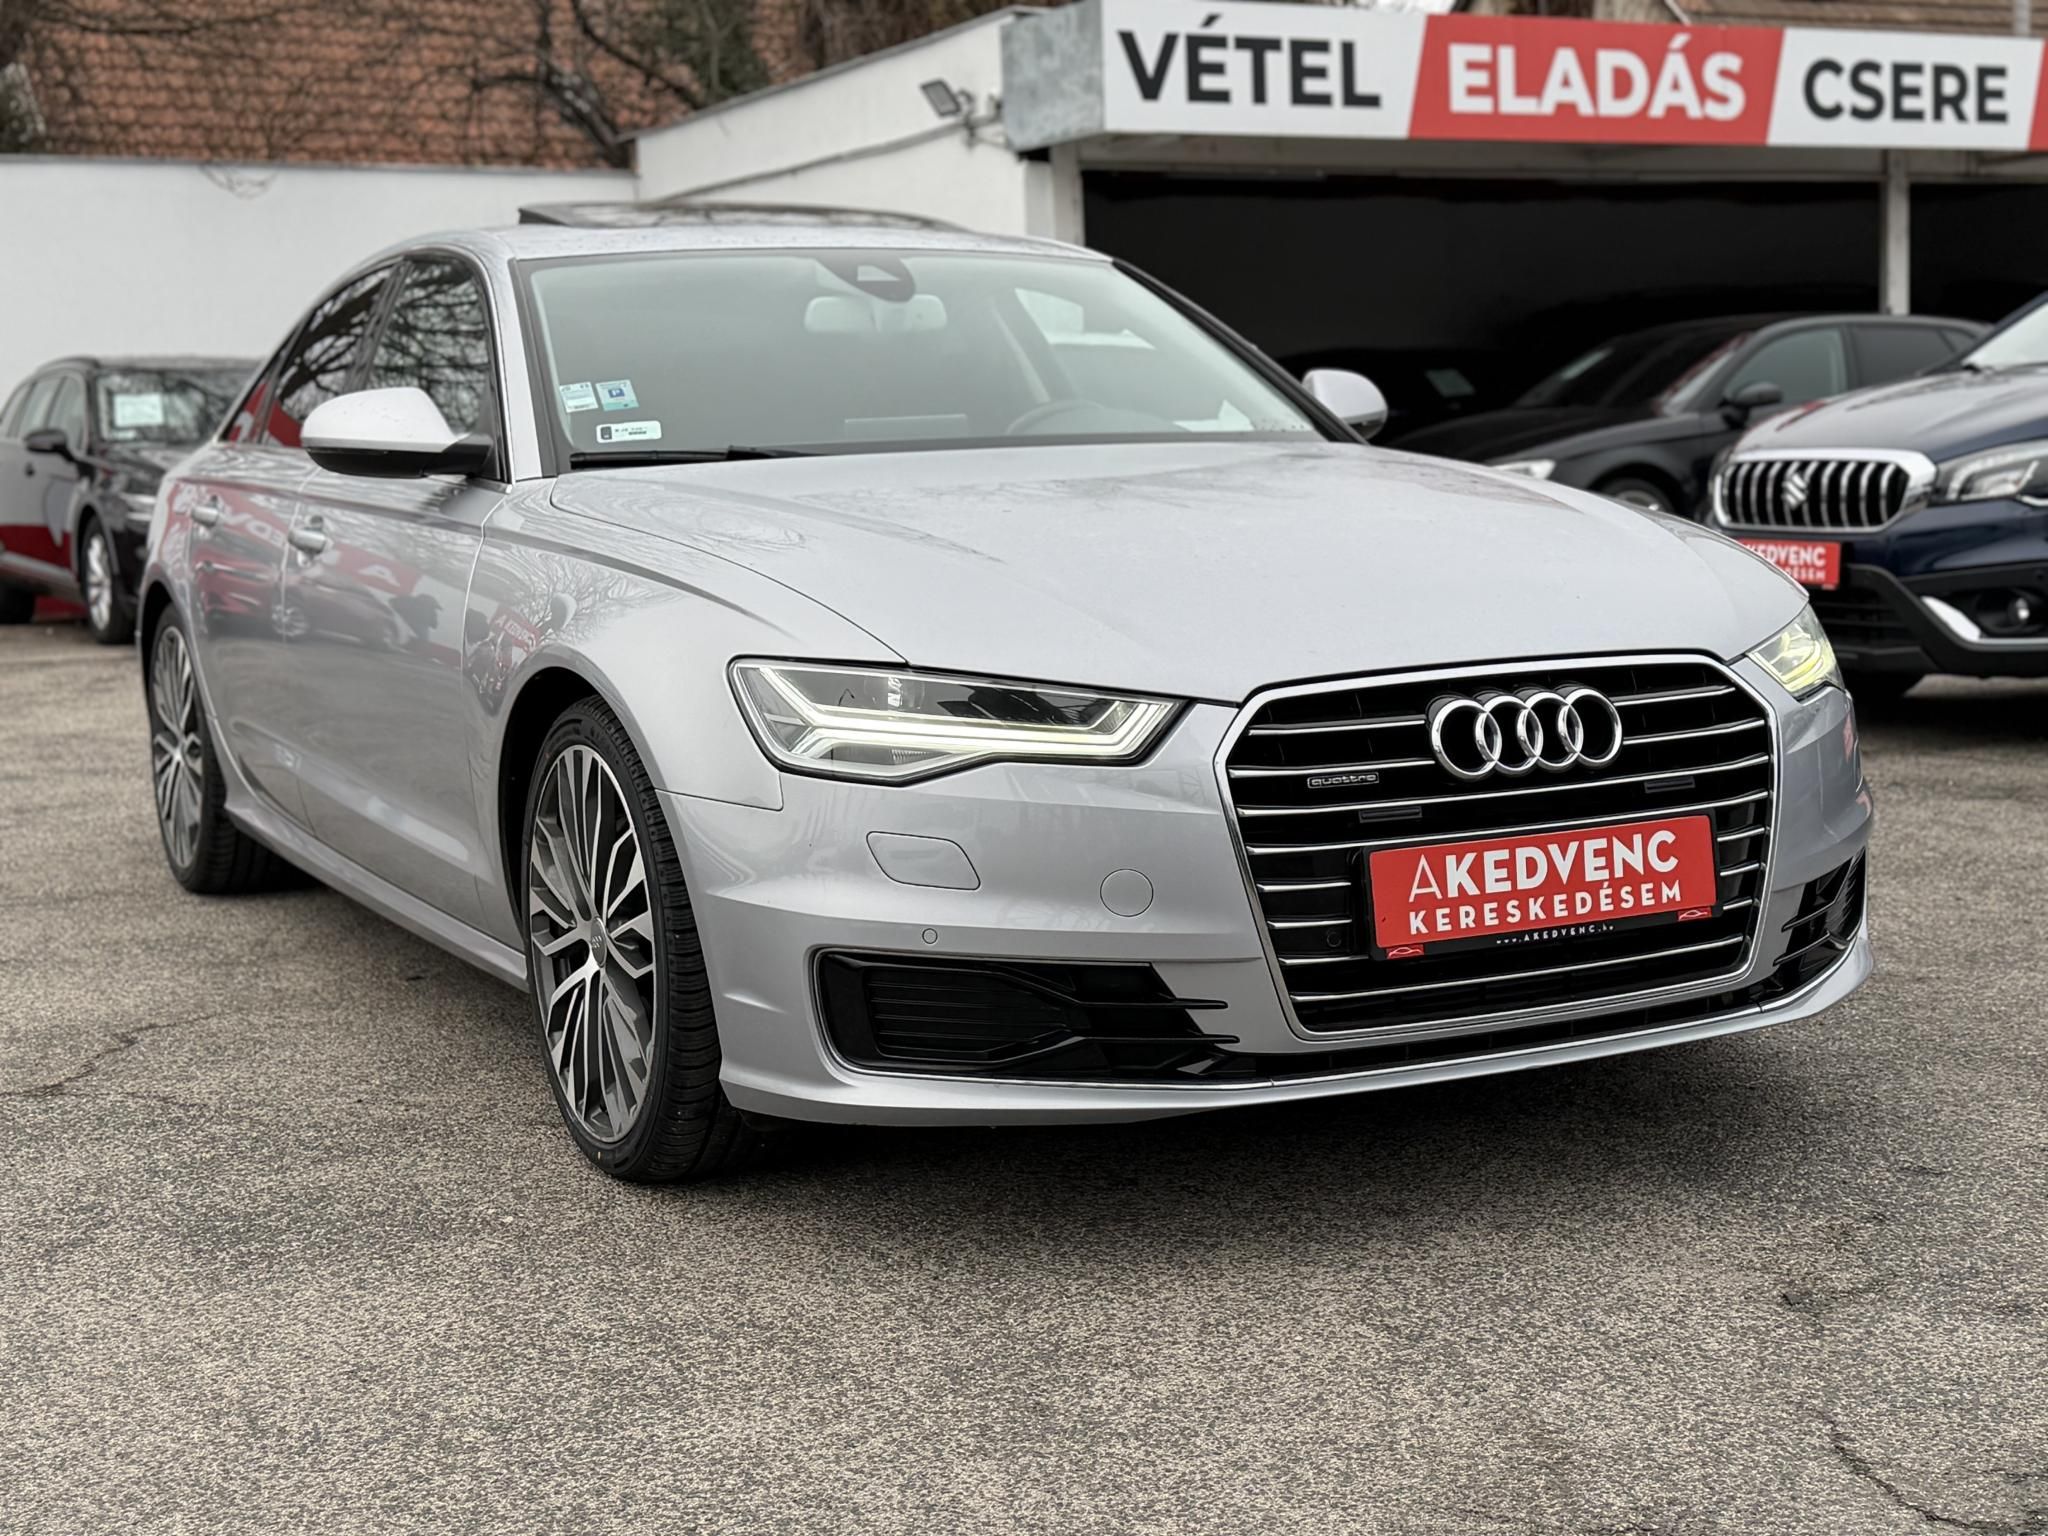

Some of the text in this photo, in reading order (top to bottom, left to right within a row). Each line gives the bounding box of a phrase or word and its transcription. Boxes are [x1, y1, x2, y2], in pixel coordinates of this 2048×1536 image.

[1117, 13, 2009, 124] VÉTEL ELADÁS CSERE
[1311, 774, 1377, 787] quattro
[1408, 829, 1680, 903] AKEDVENC
[1408, 879, 1682, 936] KERESKEDÉSEM
